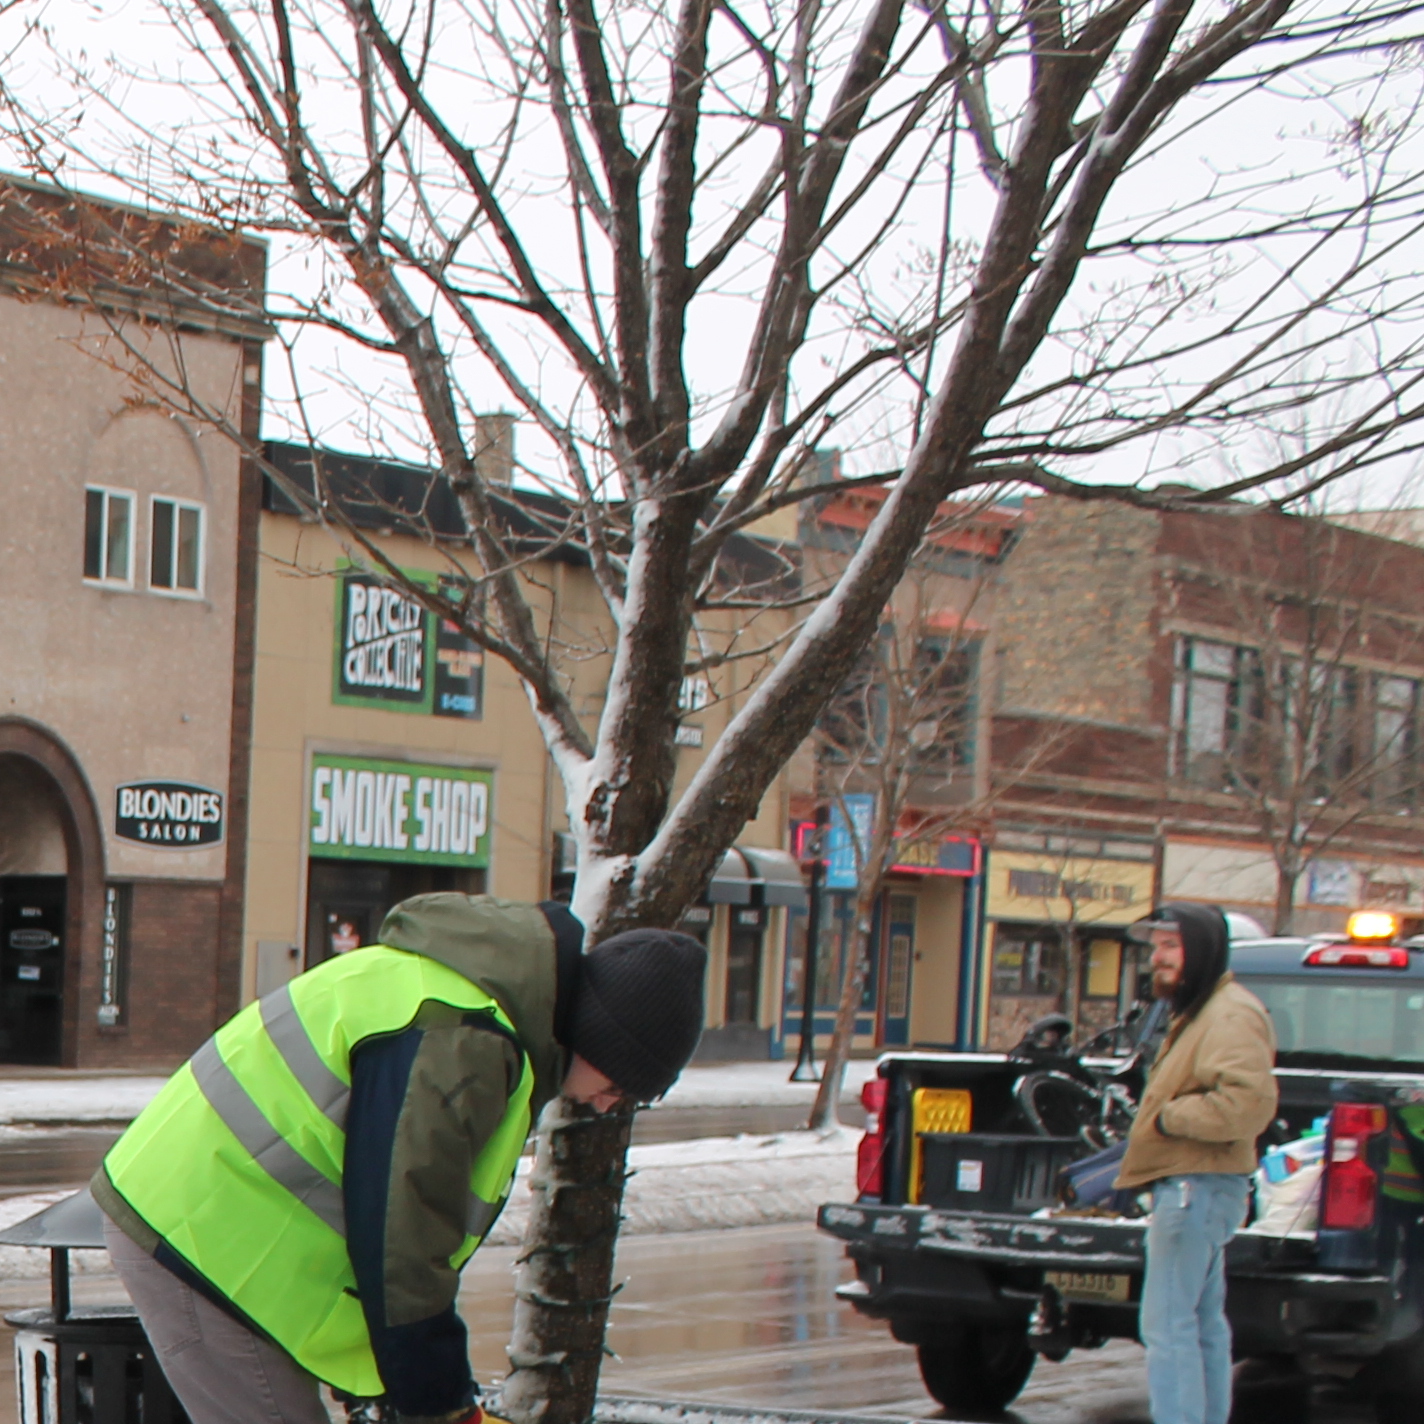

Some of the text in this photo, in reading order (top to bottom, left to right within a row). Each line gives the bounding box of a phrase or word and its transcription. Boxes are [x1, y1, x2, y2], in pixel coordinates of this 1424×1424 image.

[343, 629, 423, 692] COLLECTIVE
[119, 788, 222, 823] BLONDIES
[312, 766, 488, 855] SMOKE SHOP
[138, 822, 201, 841] SALON
